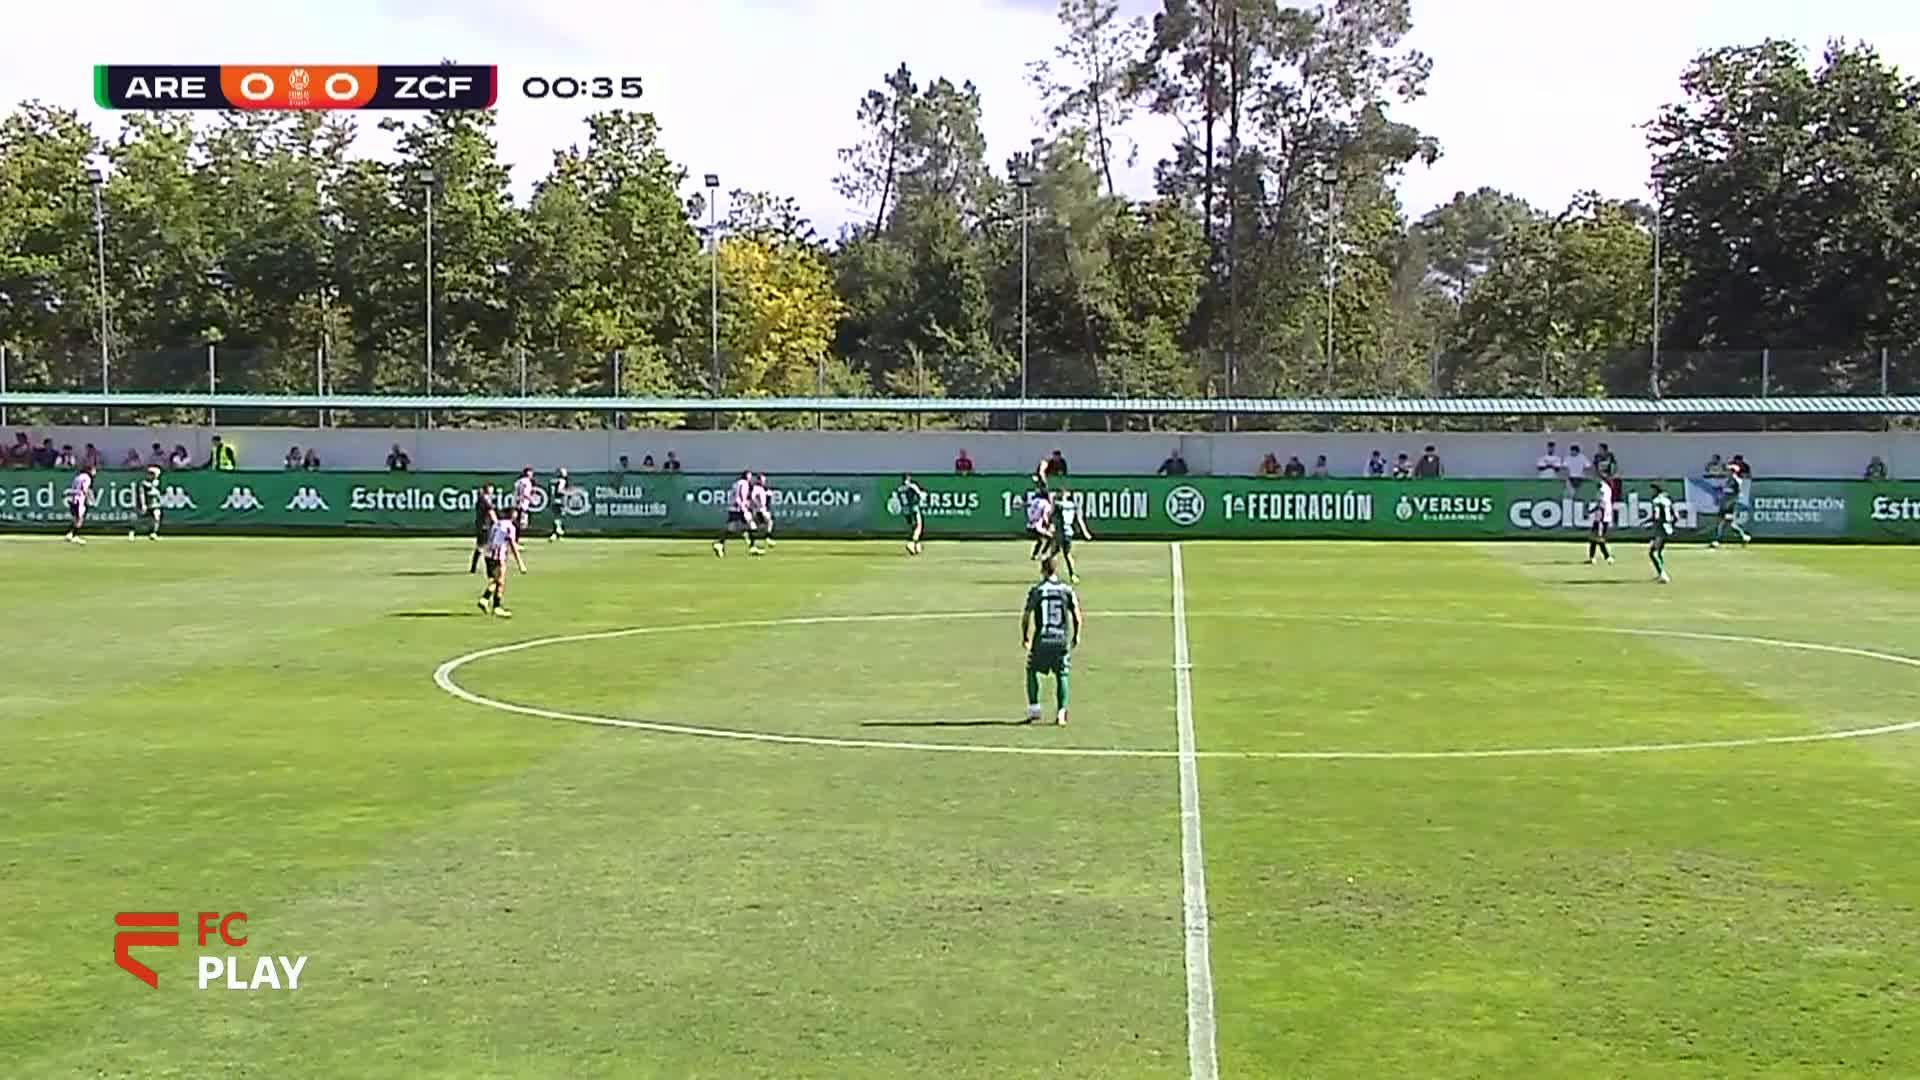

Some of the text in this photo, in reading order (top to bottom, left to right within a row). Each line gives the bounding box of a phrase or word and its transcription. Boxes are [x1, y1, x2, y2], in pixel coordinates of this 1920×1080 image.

[350, 486, 515, 510] Estrella Galia
[919, 492, 979, 508] ERSUS
[1248, 489, 1373, 521] FEDERACIÓN
[1412, 496, 1493, 513] VERSUS
[1509, 491, 1698, 528] coluba
[1041, 599, 1063, 626] 15
